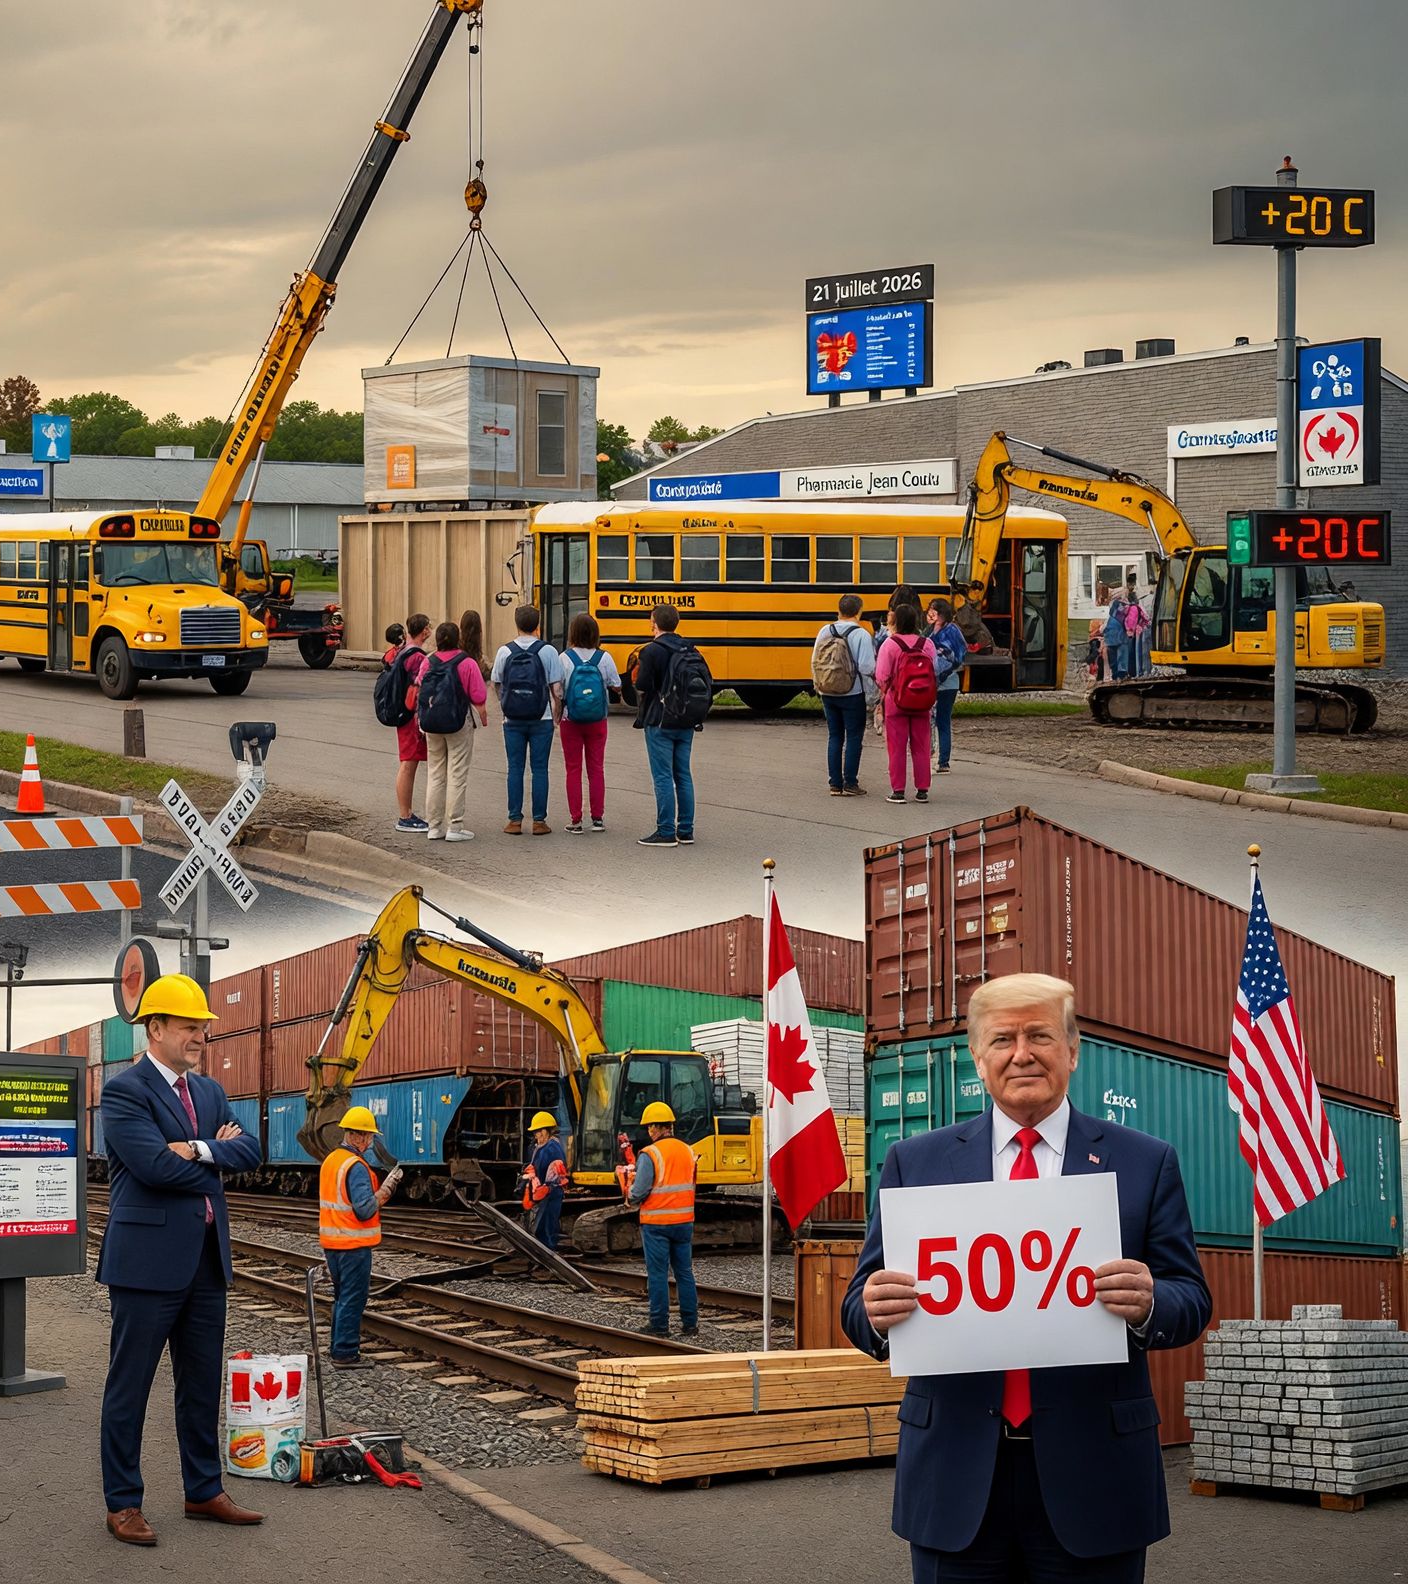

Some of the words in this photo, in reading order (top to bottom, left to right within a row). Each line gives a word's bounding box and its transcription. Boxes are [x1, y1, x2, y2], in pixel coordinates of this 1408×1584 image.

[1262, 196, 1331, 234] +20
[1344, 198, 1363, 234] C
[813, 285, 830, 302] 21
[835, 279, 878, 303] juillet
[882, 272, 922, 294] 2026
[867, 472, 898, 494] Jean
[1272, 518, 1348, 558] +20
[1358, 519, 1379, 557] C
[917, 1228, 1097, 1316] 50%
